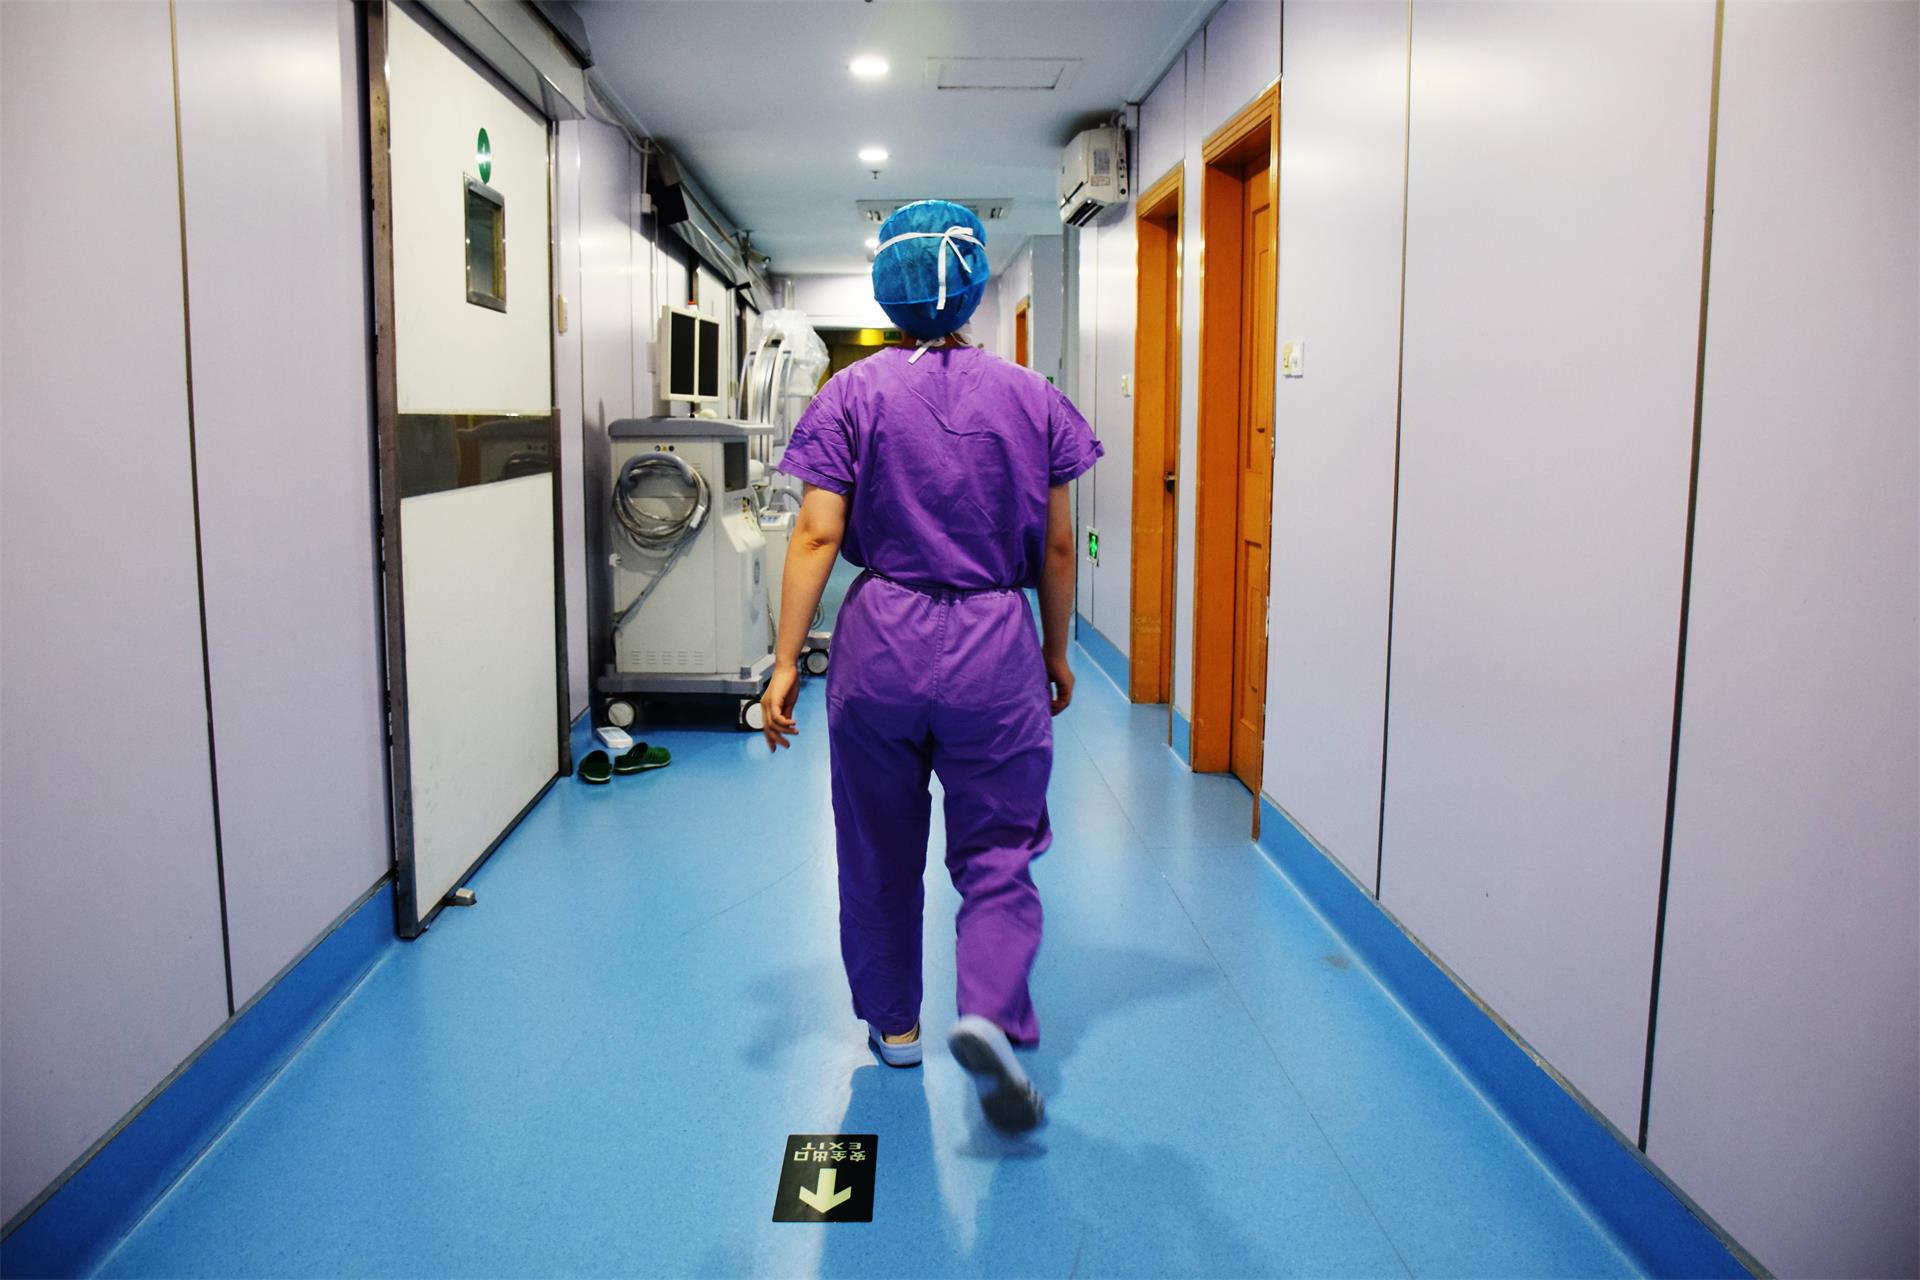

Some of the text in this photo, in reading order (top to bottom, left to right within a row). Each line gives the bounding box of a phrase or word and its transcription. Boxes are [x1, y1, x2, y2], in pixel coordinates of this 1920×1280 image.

[801, 1142, 861, 1150] EXIT
[793, 1150, 866, 1162] 安全出口
